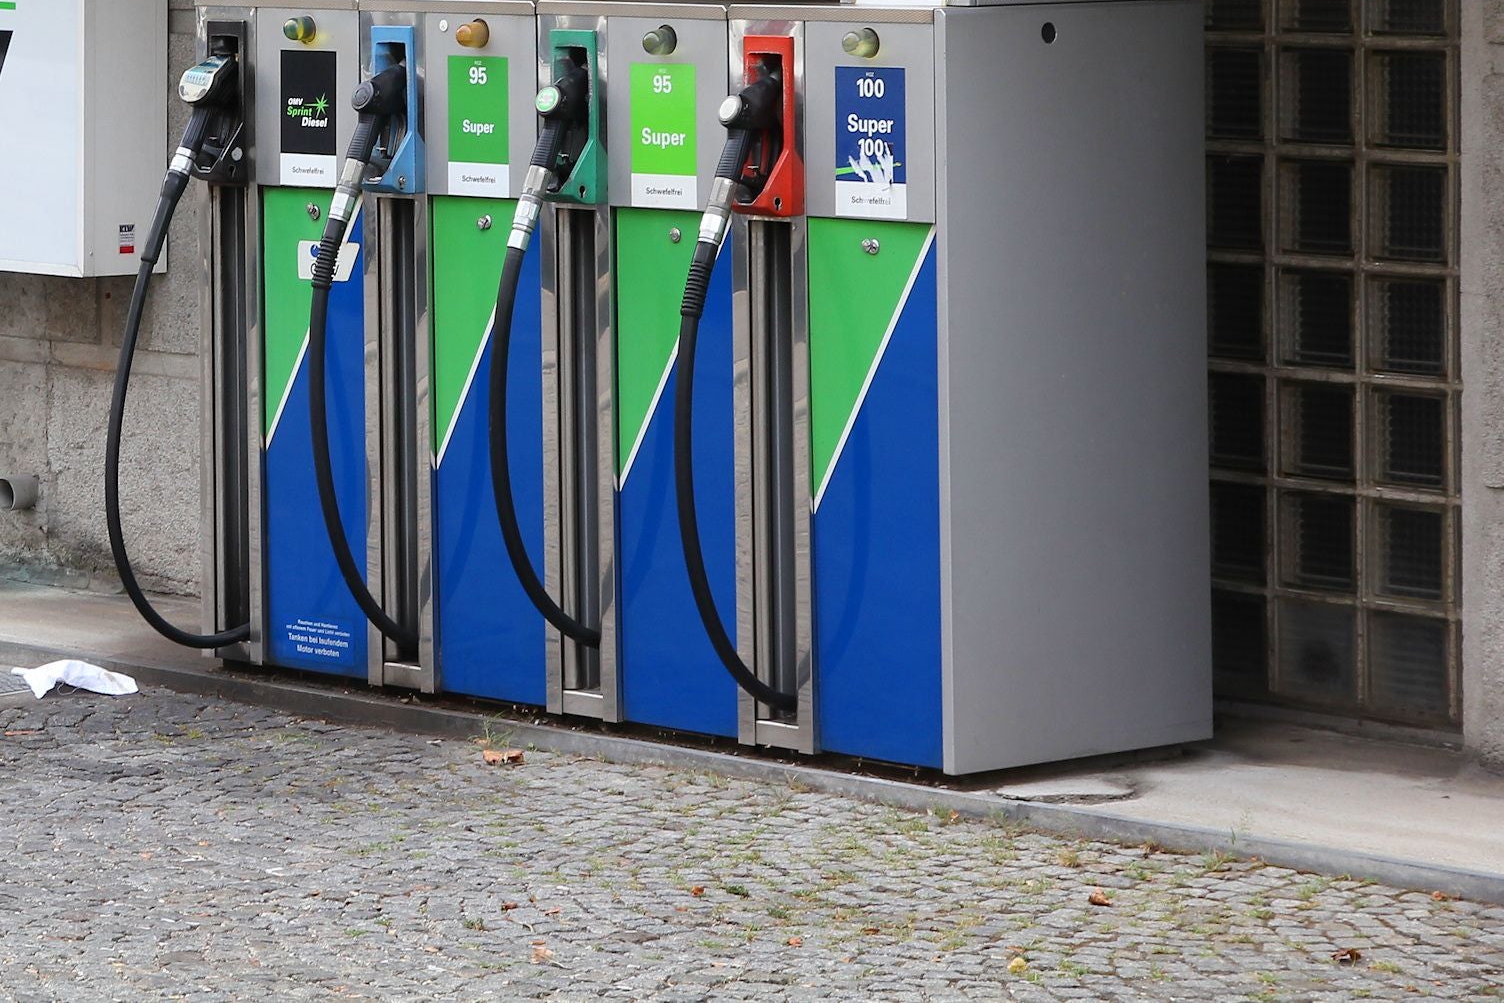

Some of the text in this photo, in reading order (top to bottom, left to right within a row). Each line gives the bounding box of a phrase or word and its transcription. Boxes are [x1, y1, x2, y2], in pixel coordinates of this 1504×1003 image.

[468, 66, 487, 85] 95
[652, 75, 672, 94] 95
[856, 78, 885, 98] 100
[288, 98, 303, 106] OMV
[287, 106, 312, 118] Sprint
[302, 116, 328, 128] Diesel
[462, 119, 495, 136] Super
[847, 114, 894, 137] Super
[641, 127, 686, 149] Super
[858, 138, 884, 157] 100
[462, 175, 496, 184] Schwefelfrei
[646, 187, 683, 196] Schwefelfrei
[288, 632, 349, 648] Tanken bei laufendem
[297, 644, 340, 658] Motor verboten
